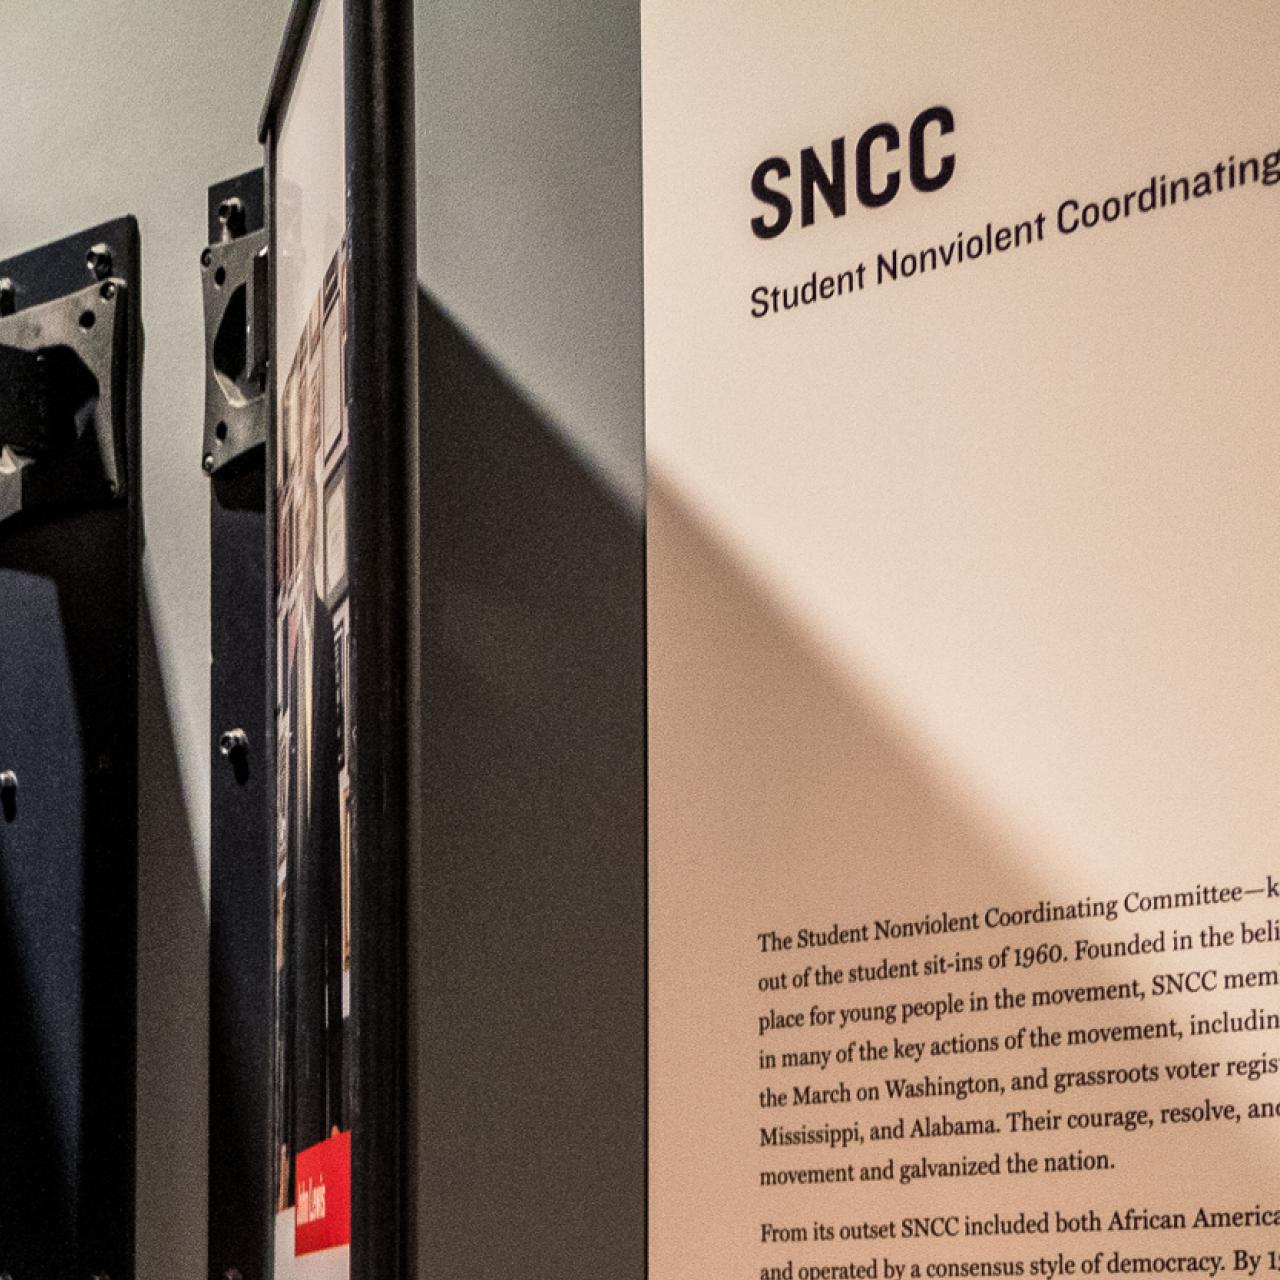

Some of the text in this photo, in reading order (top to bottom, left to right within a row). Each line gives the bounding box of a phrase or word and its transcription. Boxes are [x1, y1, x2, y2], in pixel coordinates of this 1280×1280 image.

[750, 106, 956, 239] SNCC
[751, 149, 1280, 318] Student Nonviolent Coordinating
[757, 931, 792, 952] The
[797, 924, 869, 948] Student
[874, 912, 979, 940] Nonviolent
[985, 897, 1118, 928] Coordinating
[757, 973, 787, 991] out
[792, 967, 812, 988] of
[814, 965, 843, 986] the
[849, 958, 919, 983] student
[924, 952, 983, 975] sit-ins
[988, 946, 1010, 969] of
[1014, 943, 1068, 968] 1960.
[1075, 930, 1165, 961] Founded
[1173, 930, 1193, 951] in
[1200, 925, 1234, 948] the
[759, 1009, 804, 1036] place
[809, 1005, 836, 1026] for
[840, 1005, 897, 1029] young
[902, 993, 964, 1024] people
[970, 992, 988, 1012] in
[994, 987, 1026, 1009] the
[1032, 980, 1145, 1007] movement,
[1152, 970, 1217, 996] SNCC
[759, 1050, 776, 1069] in
[782, 1050, 831, 1070] many
[836, 1041, 856, 1063] of
[859, 1040, 888, 1061] the
[894, 1038, 925, 1062] key
[930, 1034, 999, 1056] actions
[1004, 1027, 1026, 1050] of
[1029, 1026, 1061, 1048] the
[1067, 1019, 1183, 1045] movement,
[759, 1087, 787, 1108] the
[793, 1082, 851, 1106] March
[856, 1086, 879, 1101] on
[885, 1076, 1005, 1100] Washington,
[1011, 1067, 1048, 1091] and
[1054, 1064, 1159, 1093] grassroots
[1165, 1061, 1220, 1080] voter
[760, 1099, 1241, 1148] Mississippi, and Alabama. Their courage, resolve,
[760, 1150, 1115, 1186] movement and galvanized the nation.
